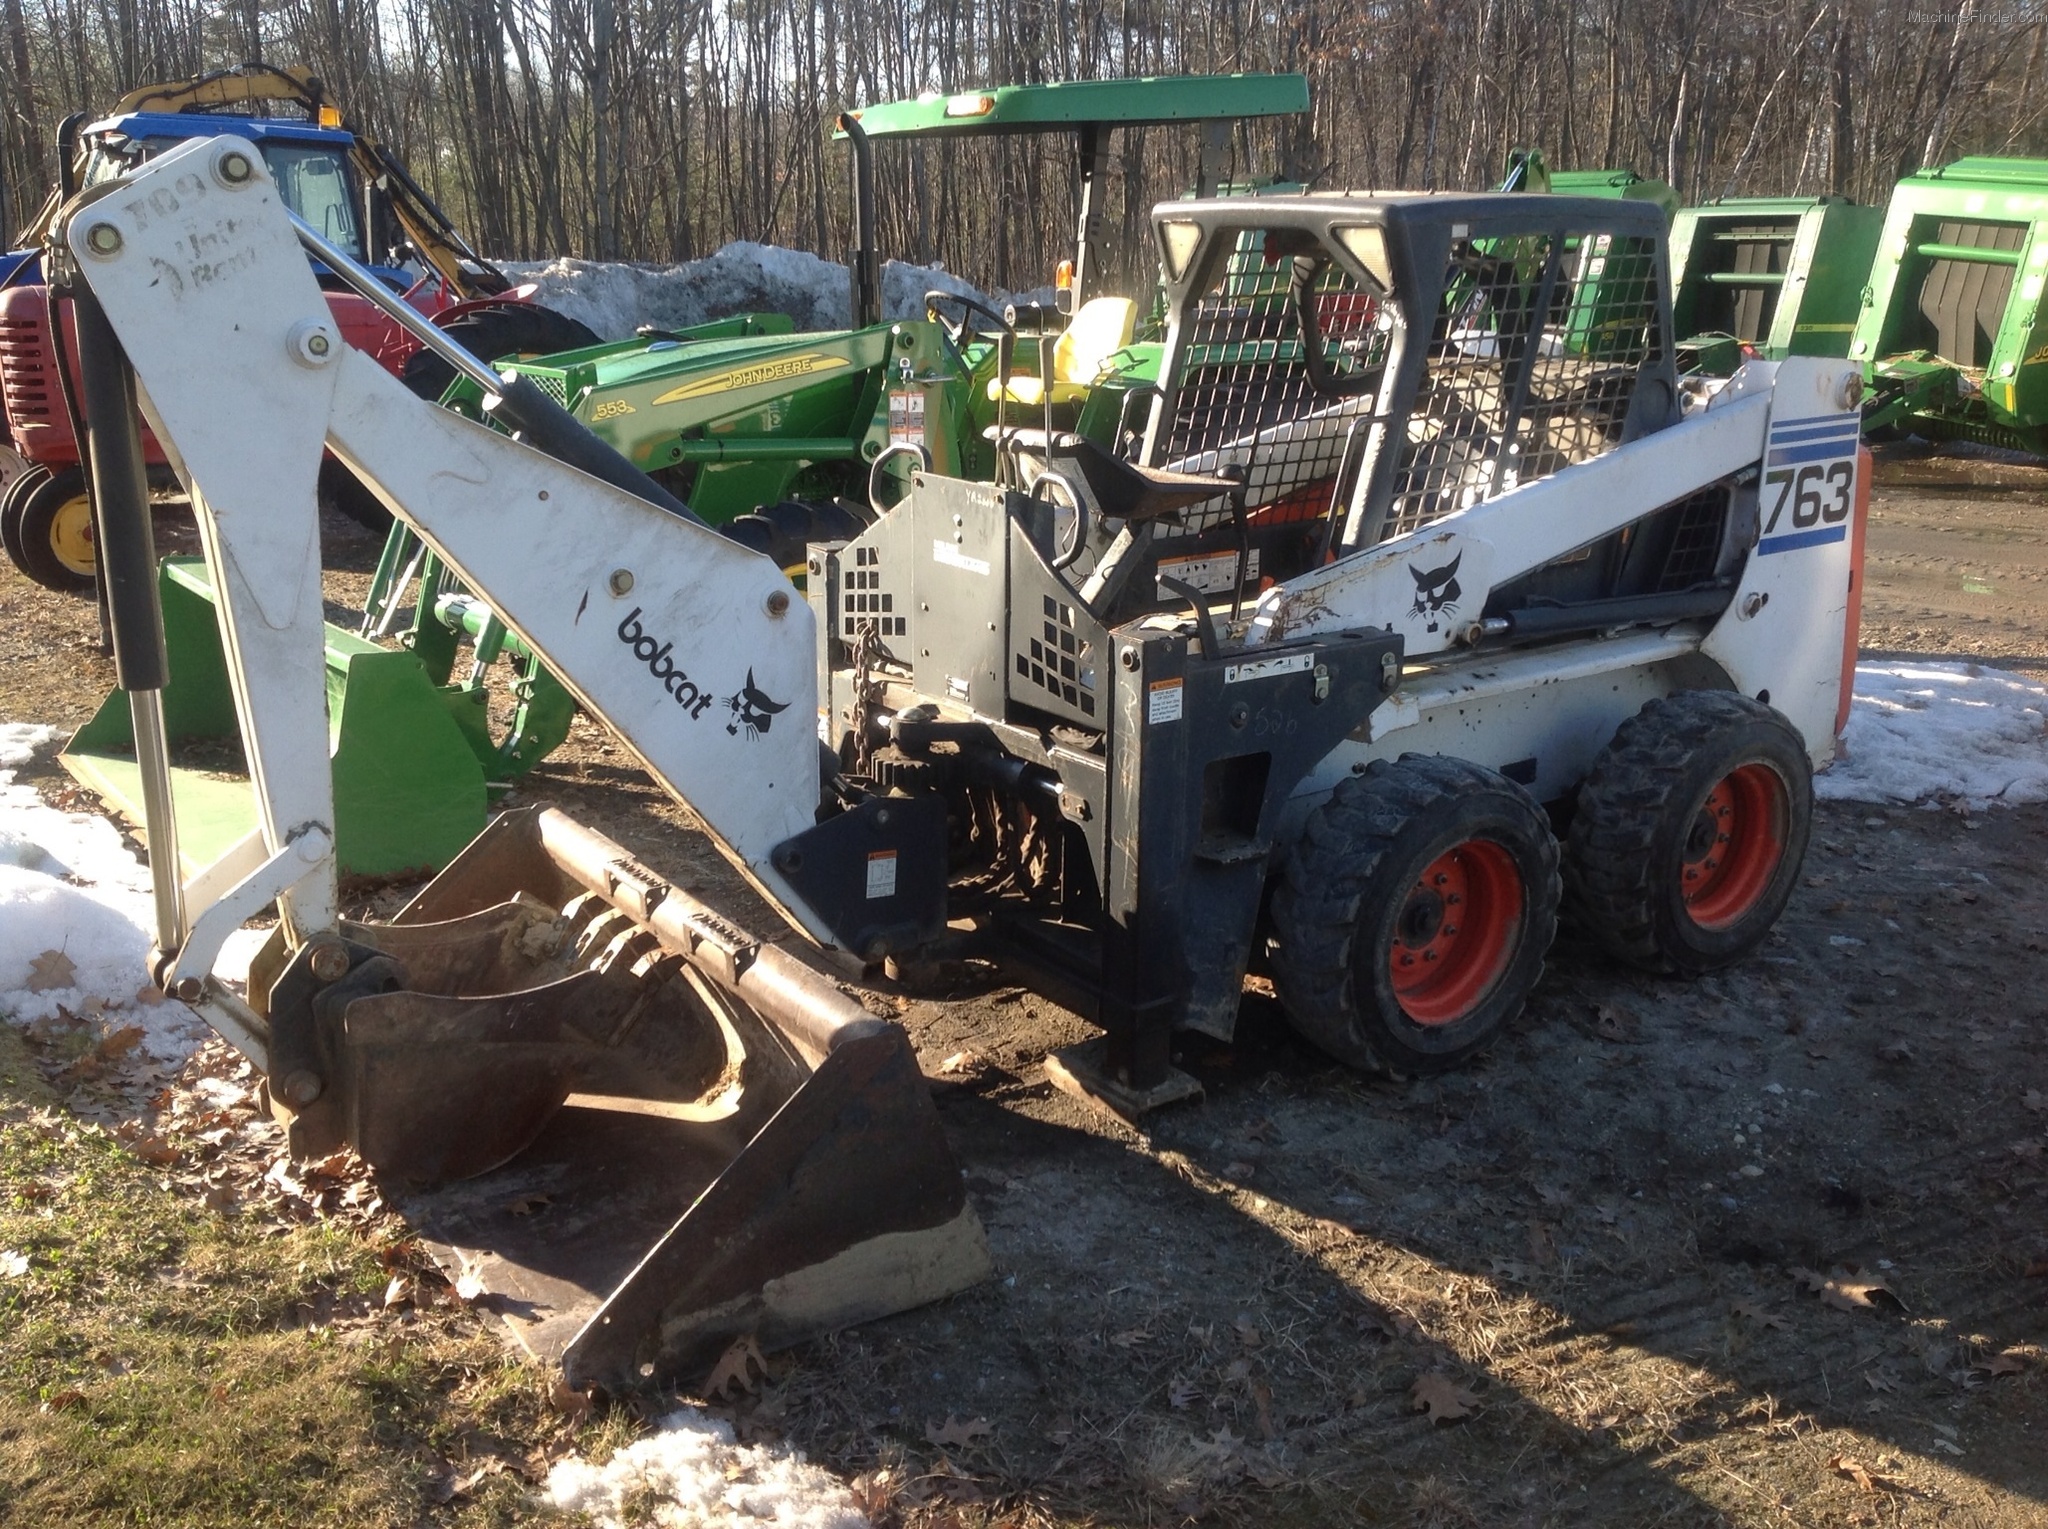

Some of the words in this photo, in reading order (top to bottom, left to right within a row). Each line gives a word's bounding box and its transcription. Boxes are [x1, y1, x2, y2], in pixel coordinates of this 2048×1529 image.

[595, 399, 628, 418] 553
[1763, 460, 1854, 536] 763
[617, 606, 714, 722] bobcat
